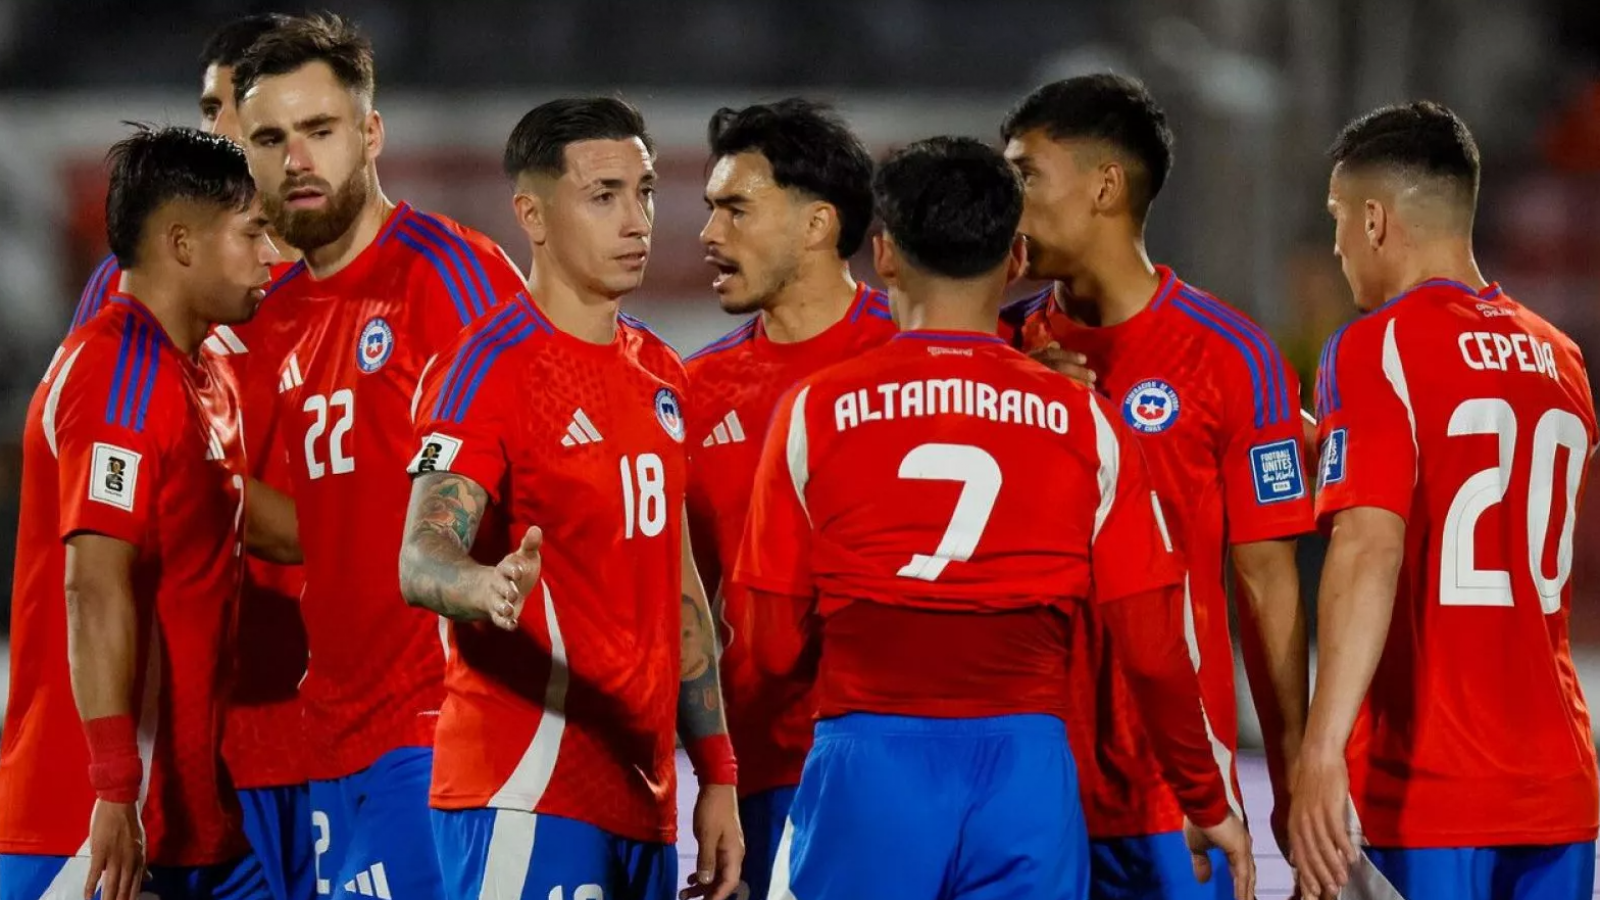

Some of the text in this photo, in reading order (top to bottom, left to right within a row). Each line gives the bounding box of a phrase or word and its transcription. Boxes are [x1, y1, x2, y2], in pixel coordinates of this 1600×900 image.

[1457, 331, 1560, 383] CEPEDA
[302, 388, 355, 480] 22
[834, 378, 1070, 435] ALTAMIRANO
[620, 452, 667, 540] 18
[1262, 459, 1293, 473] UNITES
[1439, 397, 1589, 614] 20
[896, 442, 1003, 582] 7
